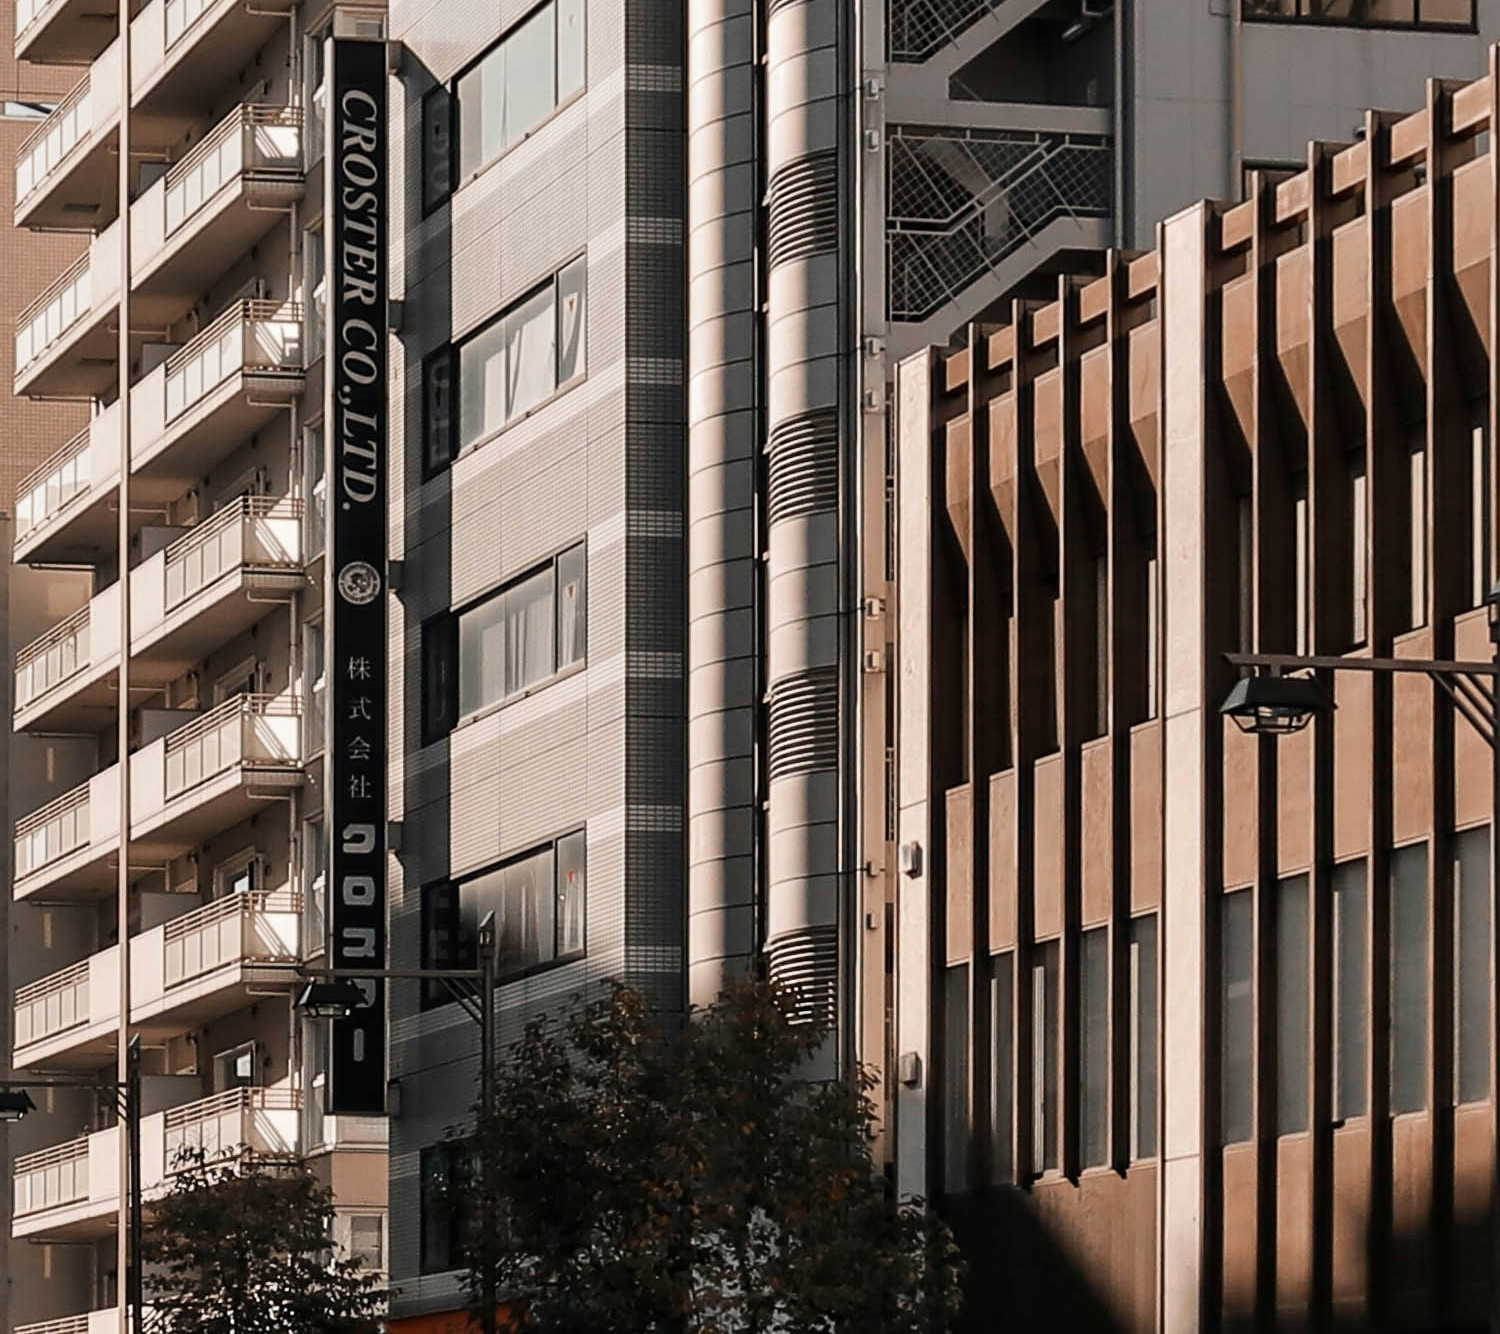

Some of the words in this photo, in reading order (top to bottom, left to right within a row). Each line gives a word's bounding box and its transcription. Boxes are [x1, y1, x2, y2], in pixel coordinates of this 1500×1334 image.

[342, 89, 378, 307] CROSTER
[347, 656, 373, 799] 株式会社
